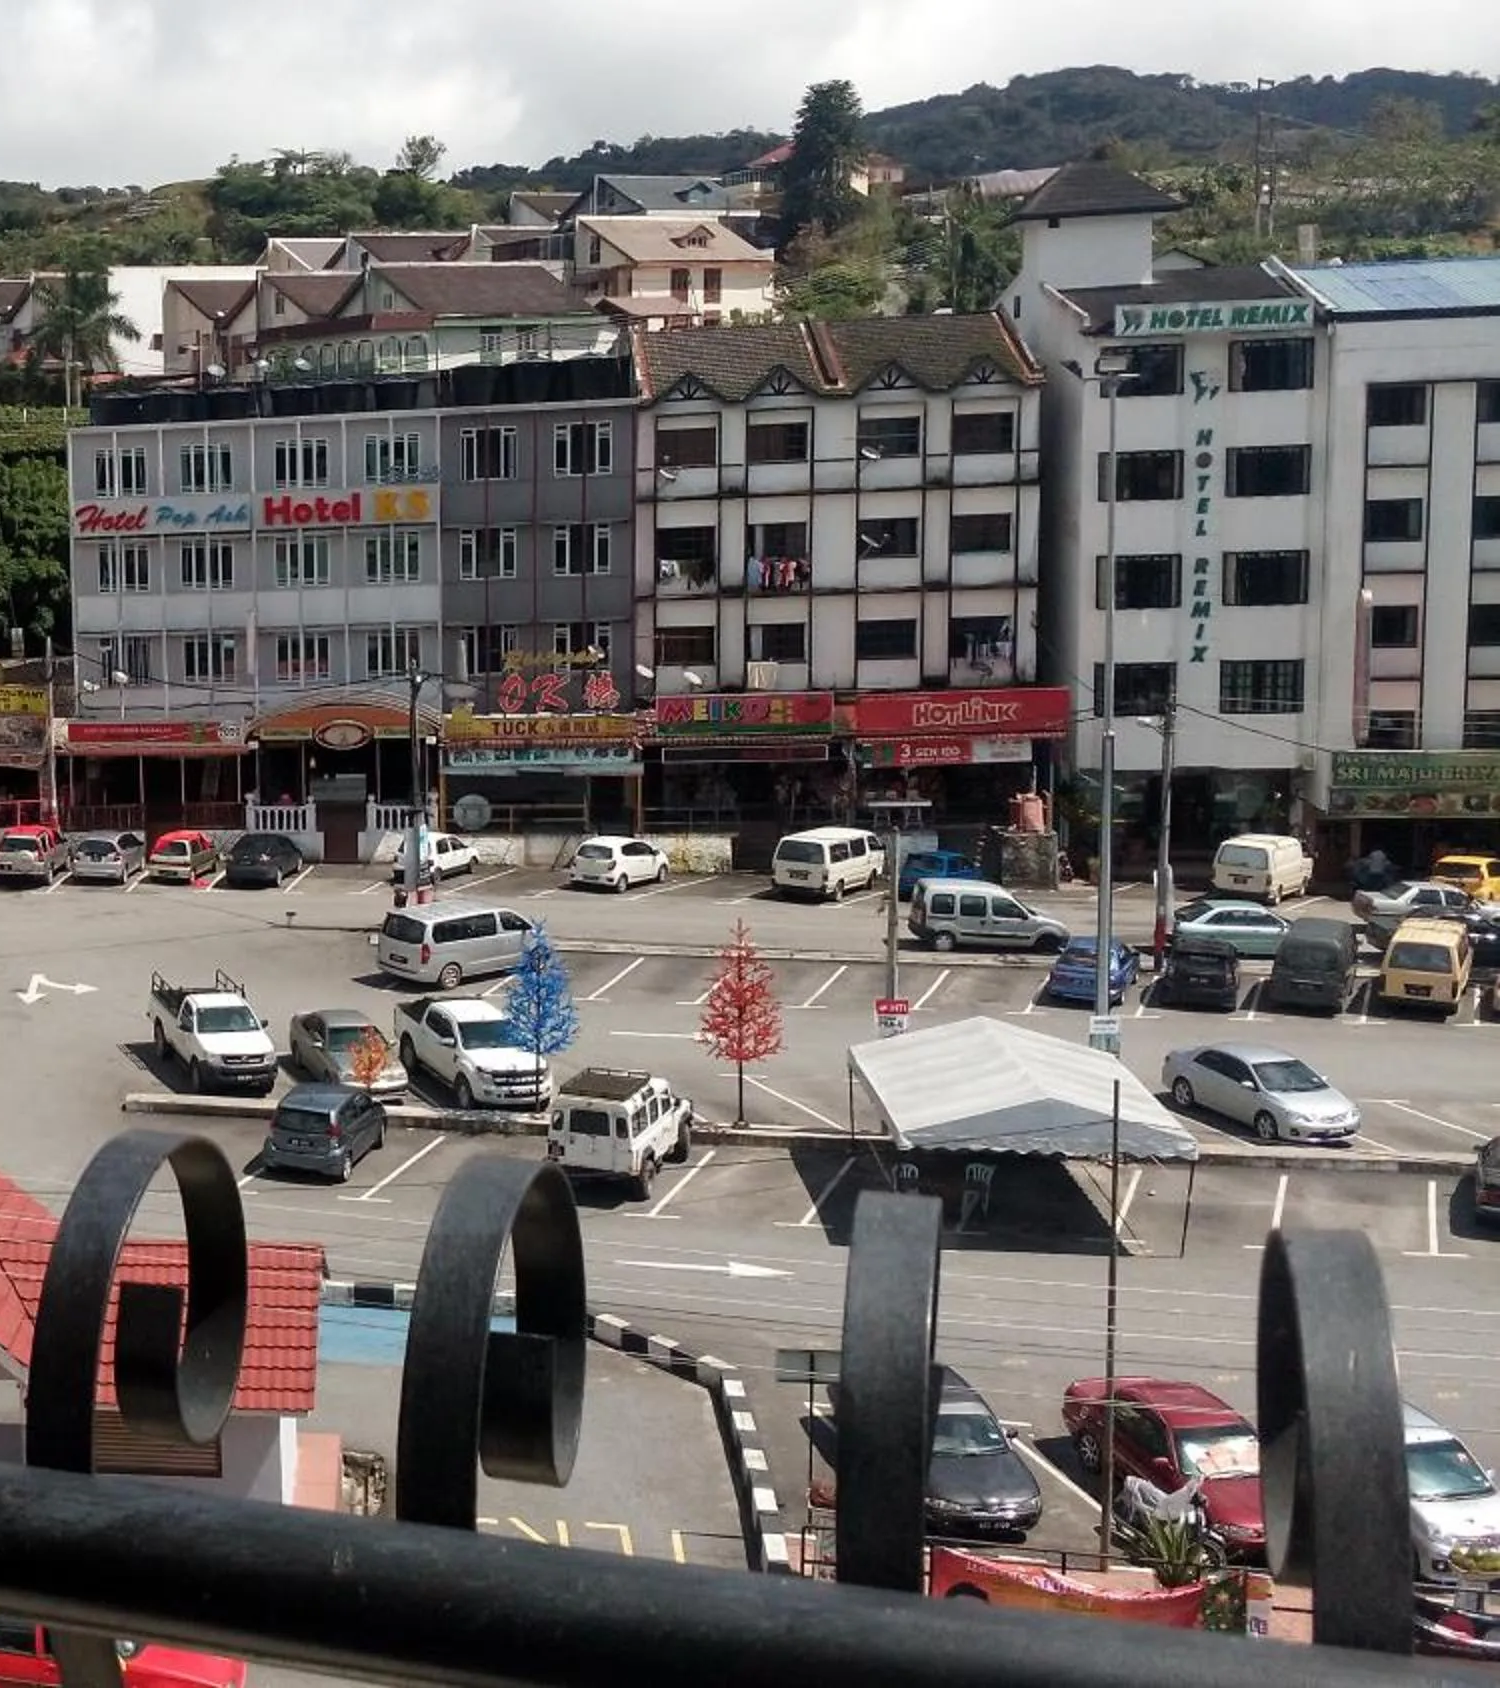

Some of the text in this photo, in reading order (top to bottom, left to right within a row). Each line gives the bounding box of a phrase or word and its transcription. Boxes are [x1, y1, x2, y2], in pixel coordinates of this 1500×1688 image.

[1149, 303, 1310, 330] HOTEL REMIX
[76, 505, 148, 533] Hotel
[264, 493, 362, 526] Hotel
[1190, 429, 1214, 663] HOTEL REMIX
[492, 721, 539, 736] TUCK
[901, 743, 911, 758] 3
[1337, 765, 1369, 780] SRI
